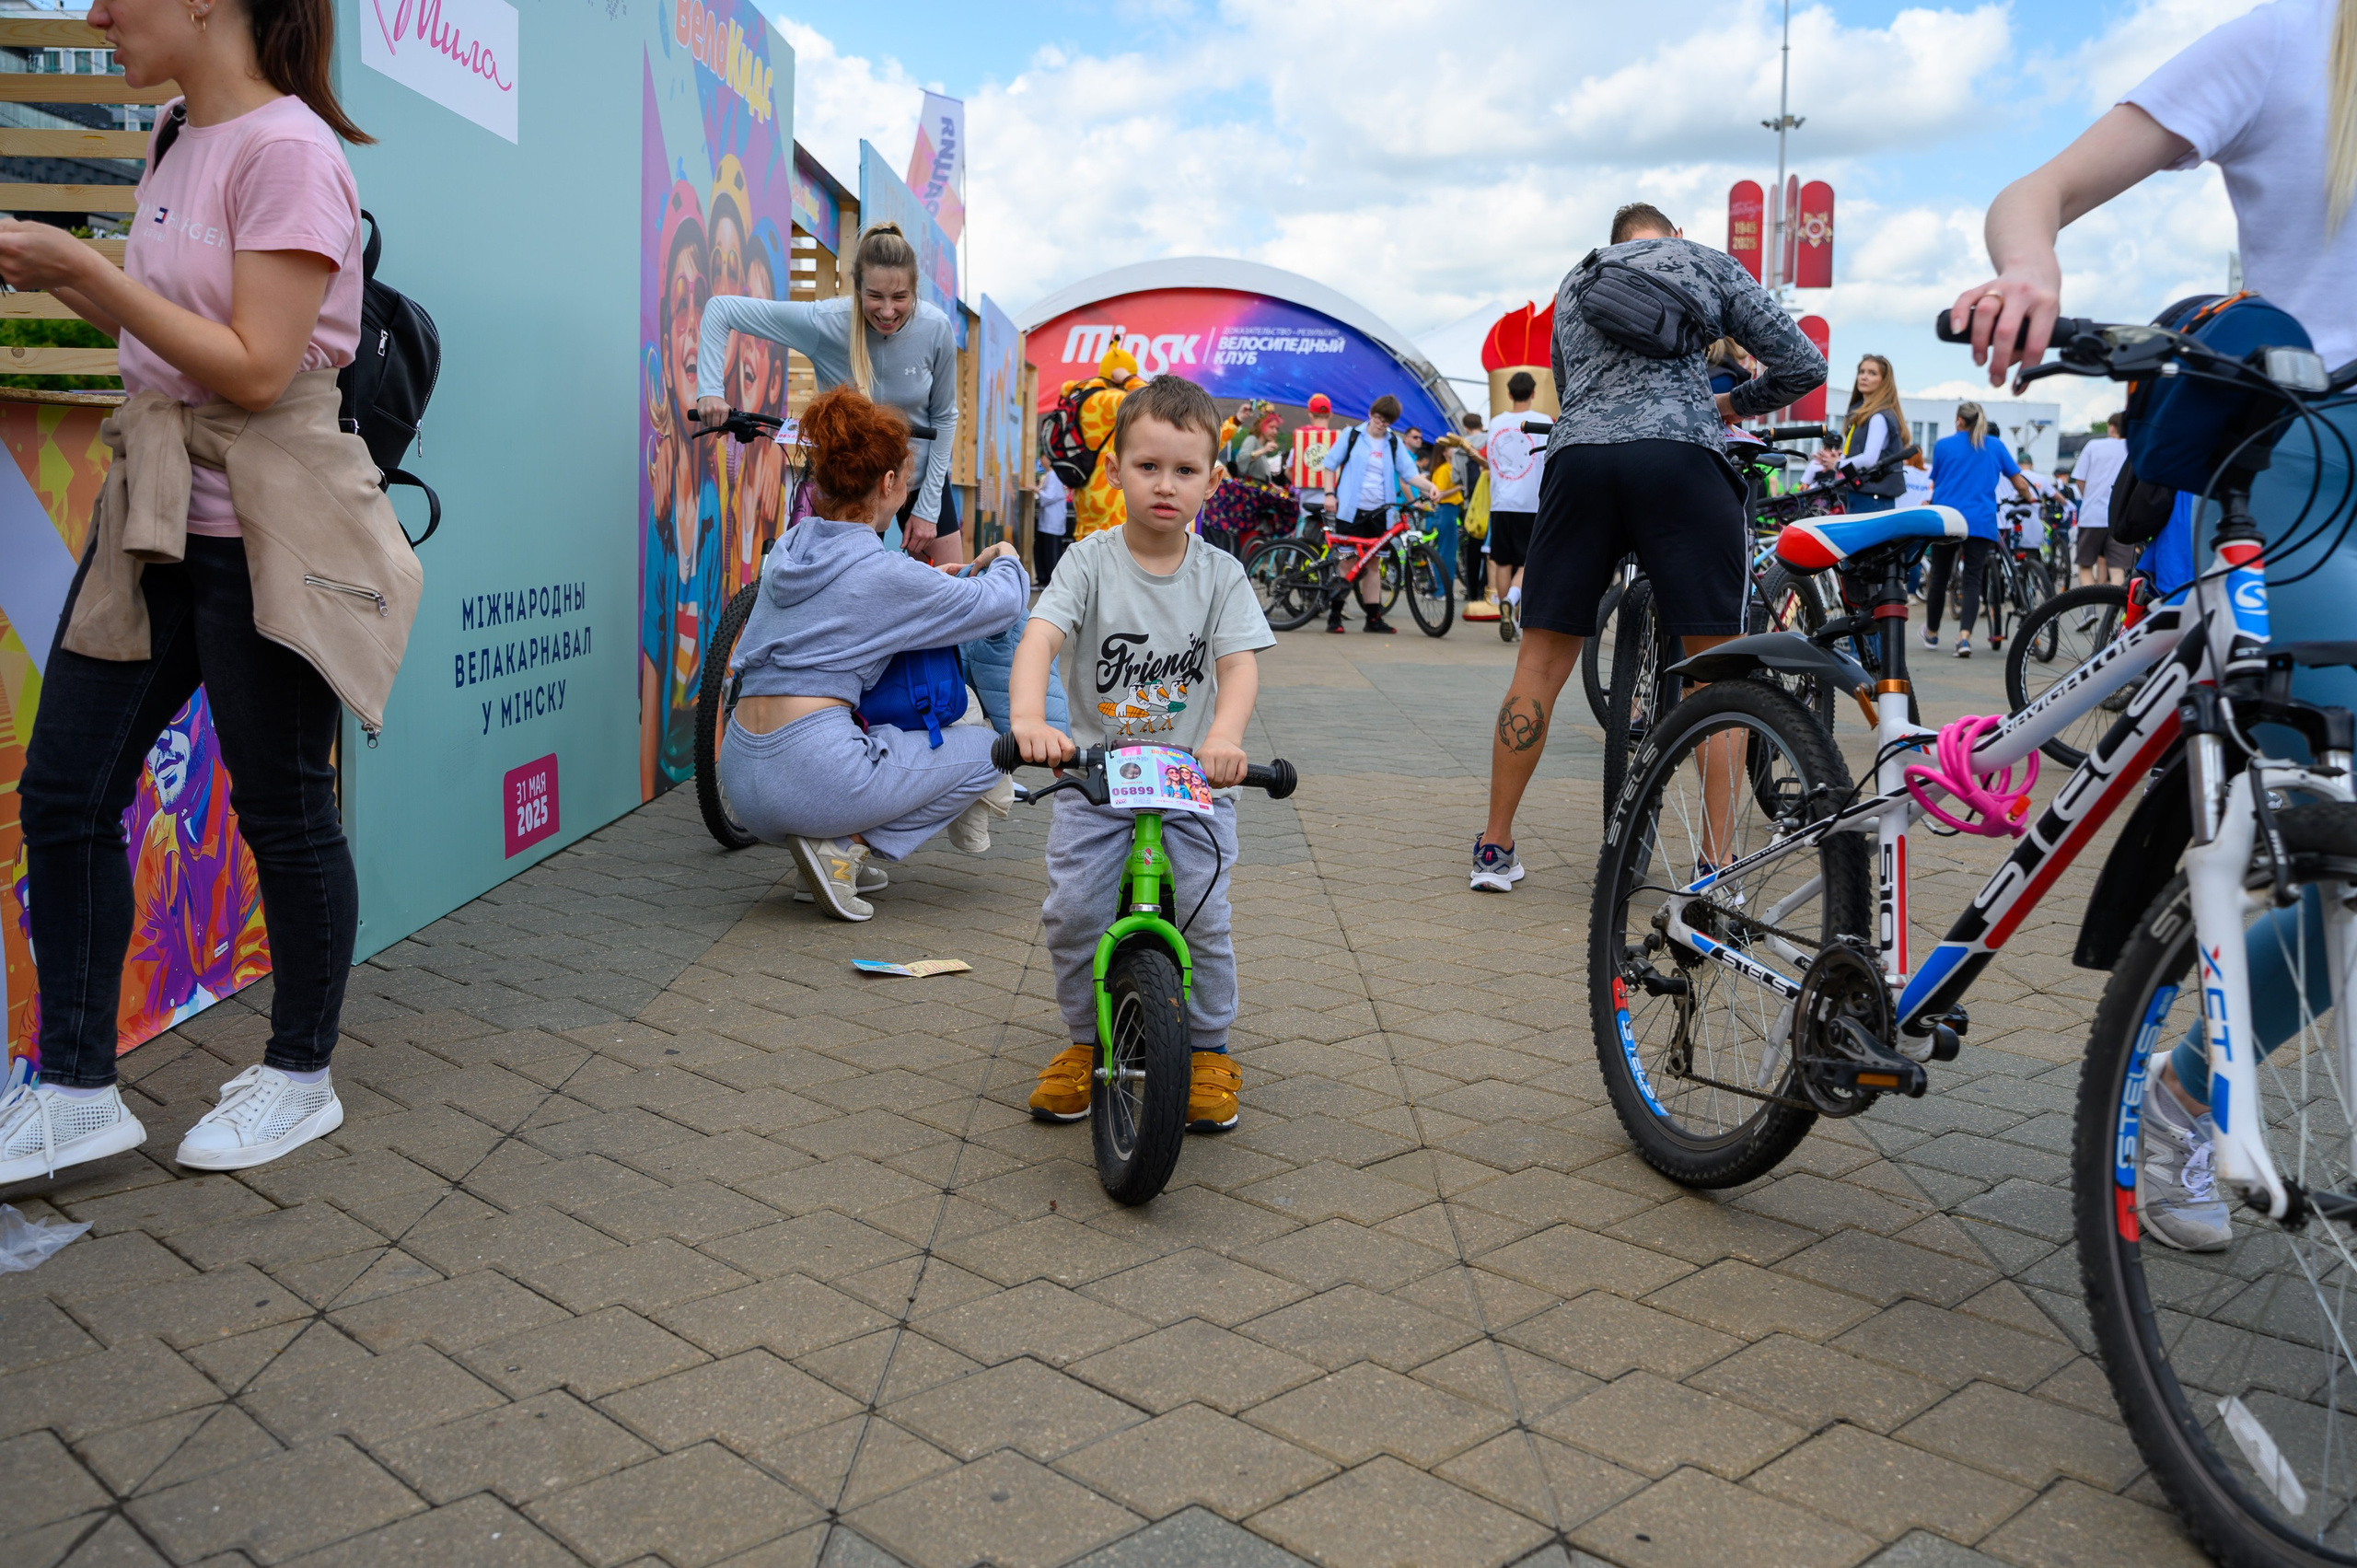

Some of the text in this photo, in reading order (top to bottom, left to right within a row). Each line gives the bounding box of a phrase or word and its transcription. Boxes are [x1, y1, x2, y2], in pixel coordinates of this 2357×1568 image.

[1213, 352, 1258, 366] КЛУБ
[1217, 336, 1346, 354] ВЕЛОСИПЕДНЫЙ
[462, 581, 586, 631] МІЖНАРОДНЫ
[455, 626, 591, 689] ВЕЛАКАРНАВАЛ
[482, 679, 566, 736] У МІНСКУ
[517, 772, 546, 806] 31 МАЯ
[1111, 786, 1155, 796] 06899
[1608, 742, 1658, 847] STELS
[517, 795, 549, 837] 2025
[1721, 949, 1788, 994] STELS
[2199, 943, 2233, 1063] XCT
[2118, 1022, 2161, 1168] STELS
